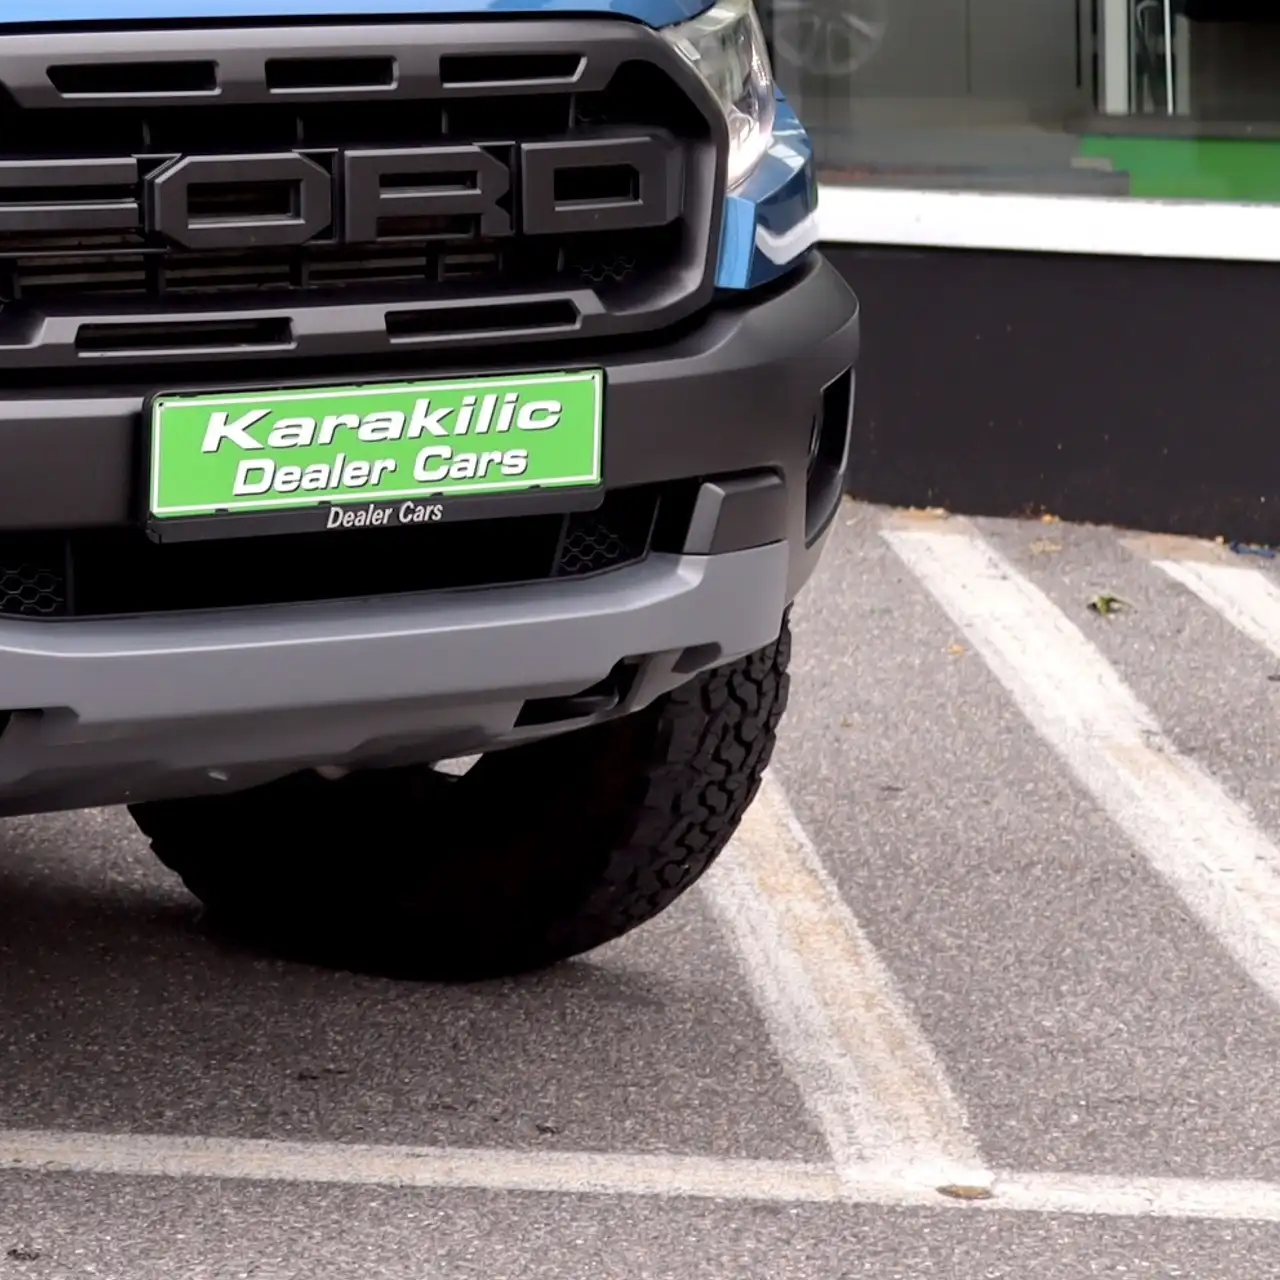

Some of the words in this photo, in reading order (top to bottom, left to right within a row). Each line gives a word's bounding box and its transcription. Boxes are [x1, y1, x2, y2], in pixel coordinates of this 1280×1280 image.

[201, 391, 563, 453] Karakilic
[232, 452, 397, 496] Dealer
[413, 445, 528, 484] Cars
[326, 503, 393, 529] Dealer
[398, 500, 443, 524] Cars
